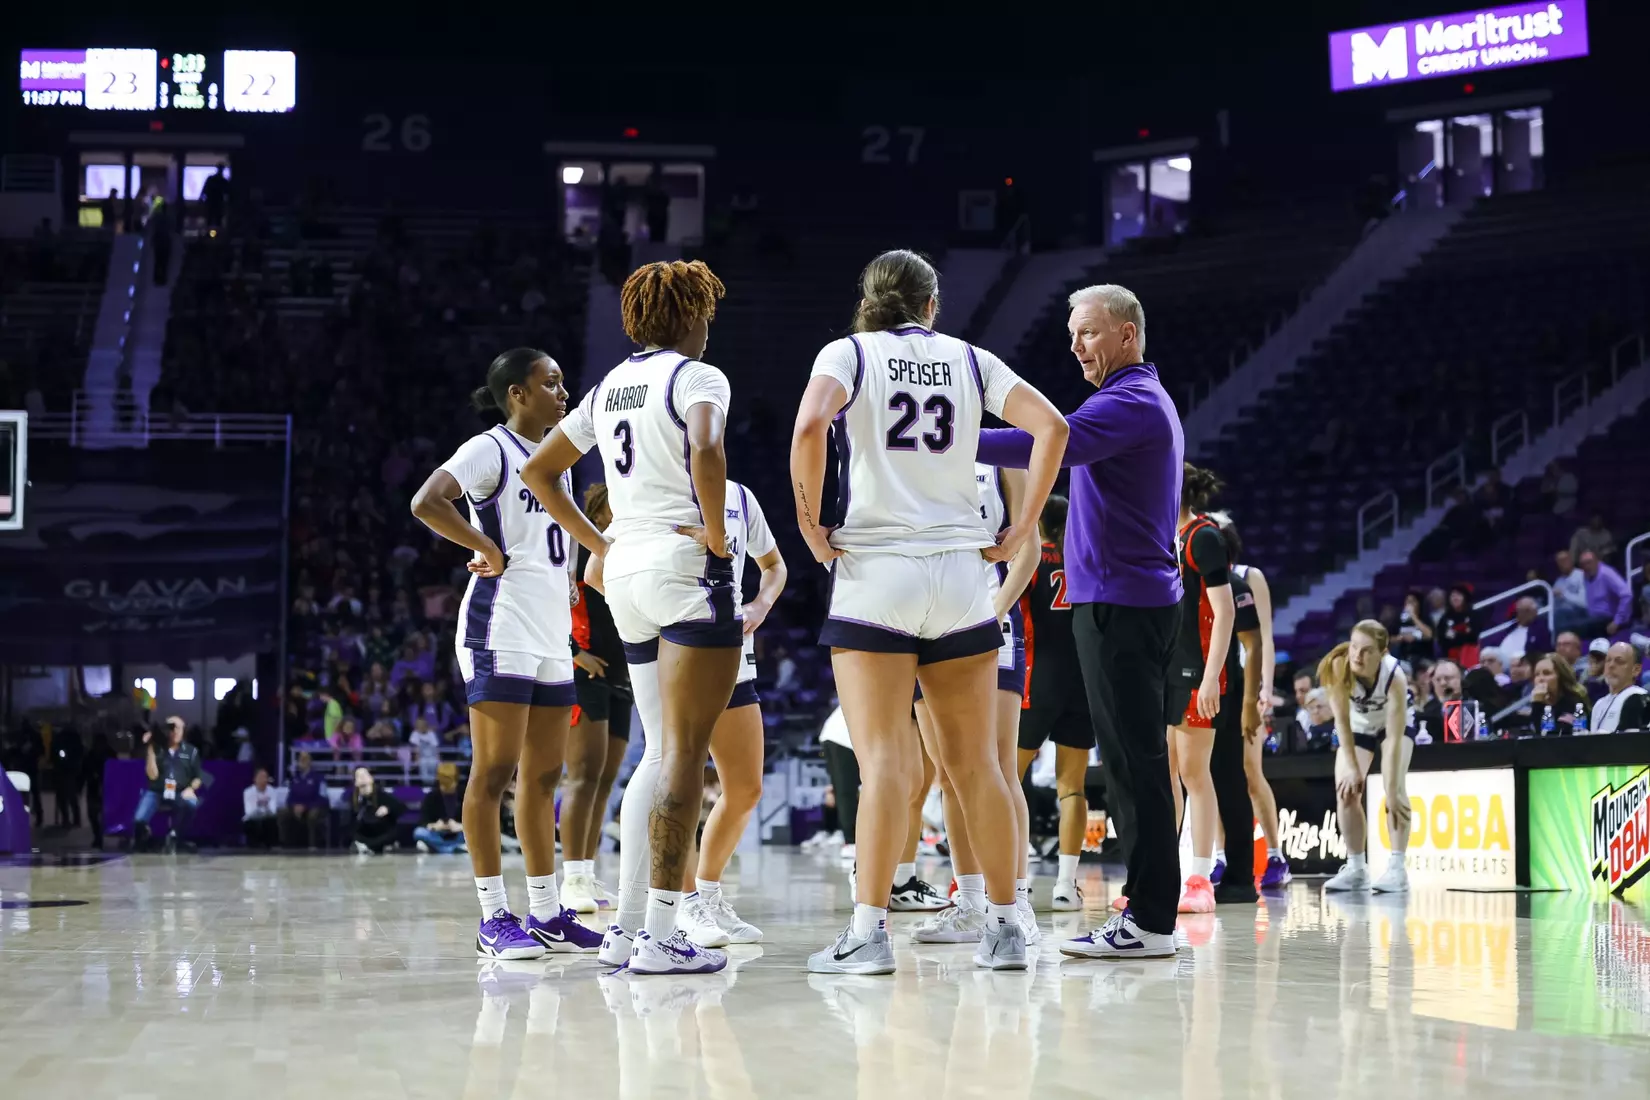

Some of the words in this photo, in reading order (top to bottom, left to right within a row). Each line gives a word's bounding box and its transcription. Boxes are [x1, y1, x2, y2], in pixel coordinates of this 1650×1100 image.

[1415, 3, 1563, 55] Meritrust
[1417, 51, 1479, 75] CREDIT
[1481, 41, 1538, 66] UNION
[60, 90, 83, 106] PM
[102, 71, 139, 95] 23
[240, 73, 277, 96] 22
[362, 113, 433, 152] 26
[861, 125, 926, 164] 27
[887, 357, 952, 387] SPEISER
[604, 383, 649, 413] HARROD
[886, 390, 956, 454] 23
[613, 418, 635, 478] 3
[545, 521, 567, 568] 0
[63, 574, 247, 599] GLAVAN
[1277, 807, 1320, 860] Pizza
[1472, 857, 1510, 875] EATS
